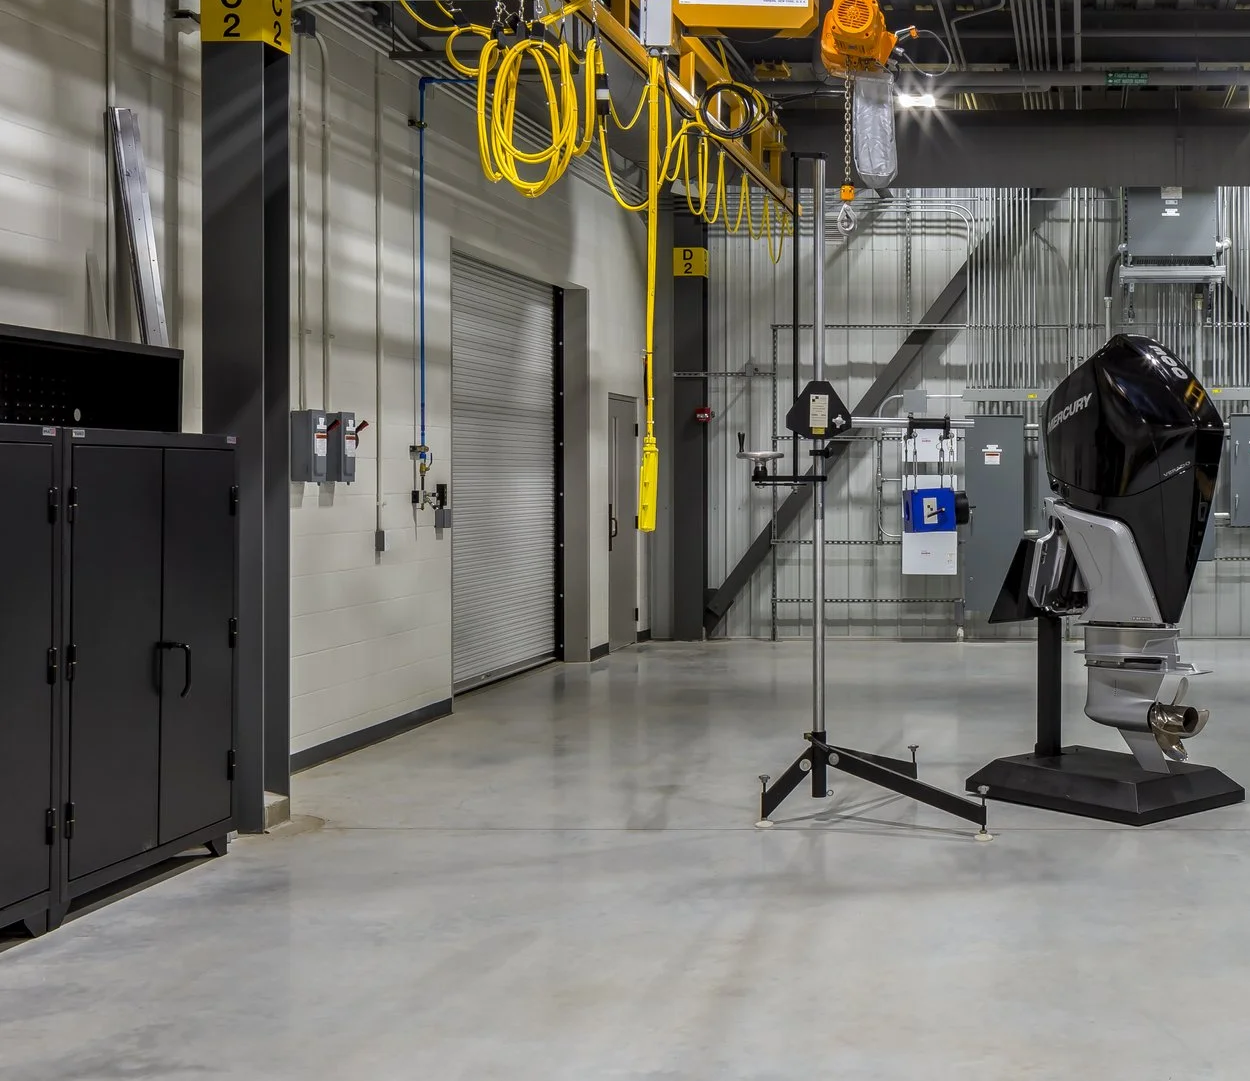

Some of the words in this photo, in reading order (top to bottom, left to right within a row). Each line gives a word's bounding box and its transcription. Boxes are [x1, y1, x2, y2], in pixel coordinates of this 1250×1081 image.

[223, 13, 241, 38] 2
[273, 20, 282, 47] 2
[682, 248, 694, 261] D
[683, 262, 693, 275] 2
[1148, 344, 1189, 380] 300
[1046, 392, 1093, 436] MERCURY
